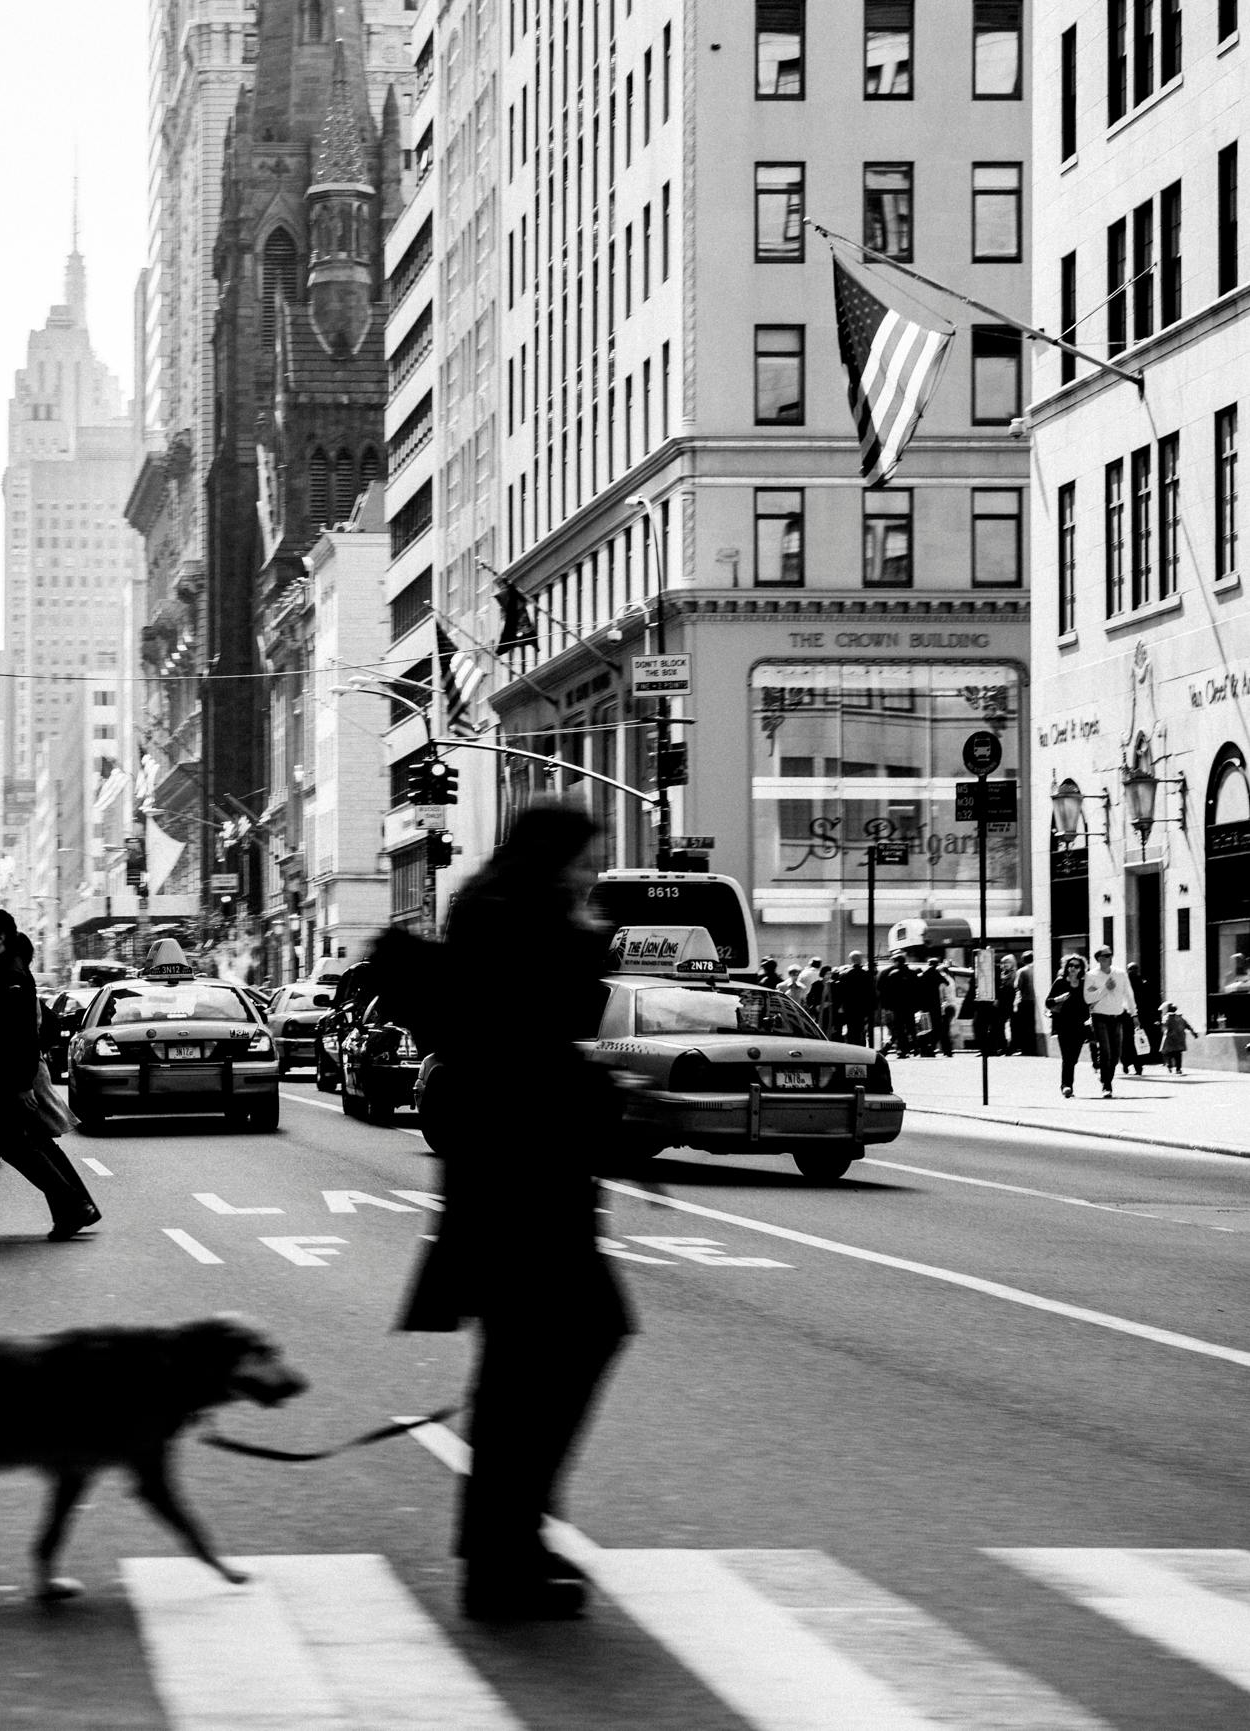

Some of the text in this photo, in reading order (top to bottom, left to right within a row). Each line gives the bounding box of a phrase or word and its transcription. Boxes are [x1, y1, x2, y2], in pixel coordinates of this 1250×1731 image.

[788, 632, 991, 649] THE CROWN BUILDING
[856, 816, 981, 868] Blgari
[647, 886, 680, 898] 8613
[627, 938, 679, 958] THE LION KING
[161, 965, 181, 974] 3N12
[690, 961, 714, 971] 2N78
